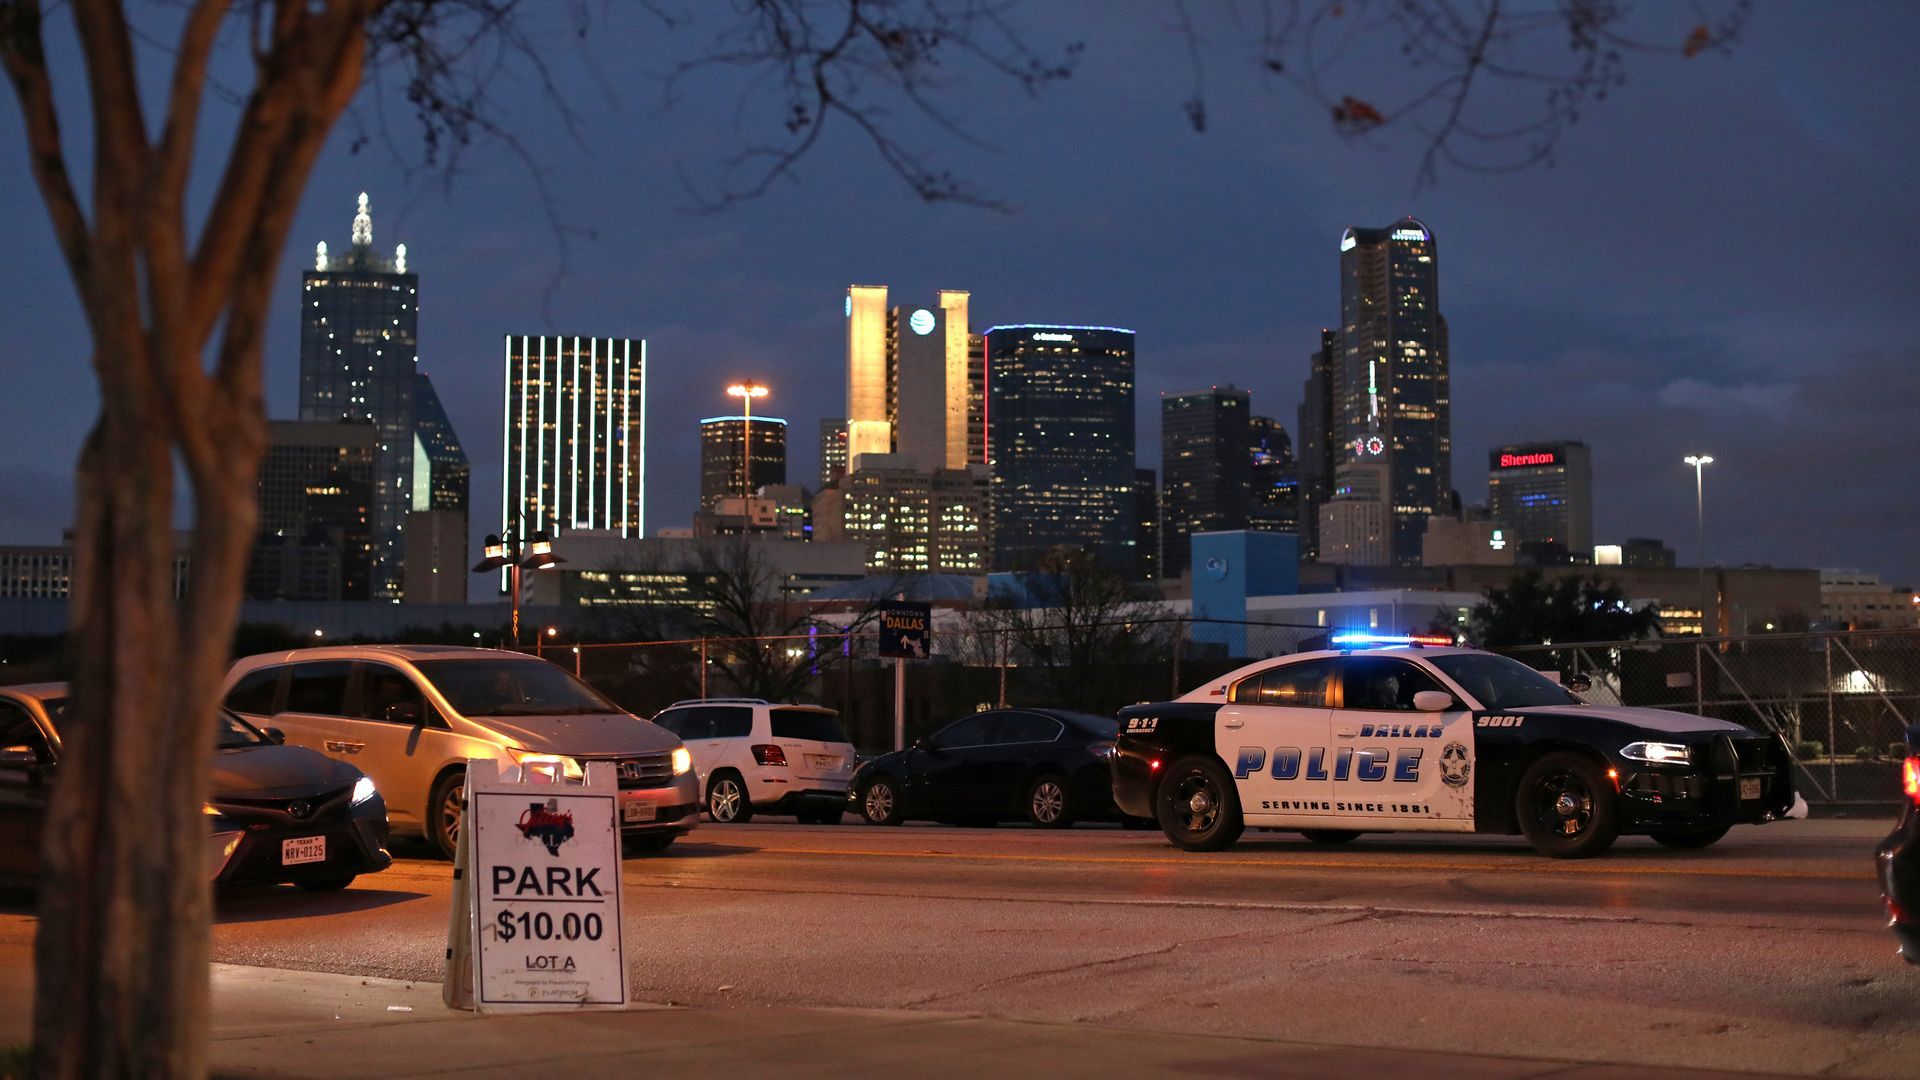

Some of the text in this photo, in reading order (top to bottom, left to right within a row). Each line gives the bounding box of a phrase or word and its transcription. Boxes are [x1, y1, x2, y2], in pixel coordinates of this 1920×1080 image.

[1501, 453, 1554, 467] Sheraton
[886, 617, 924, 630] DALLAS
[1477, 716, 1524, 727] 9001
[1360, 724, 1444, 738] DALLAS
[1235, 746, 1423, 781] POLICE
[1262, 801, 1430, 814] SERVING SINCE 1881
[492, 865, 602, 897] PARK
[497, 909, 602, 943] $10.00
[526, 955, 576, 969] LOT A
